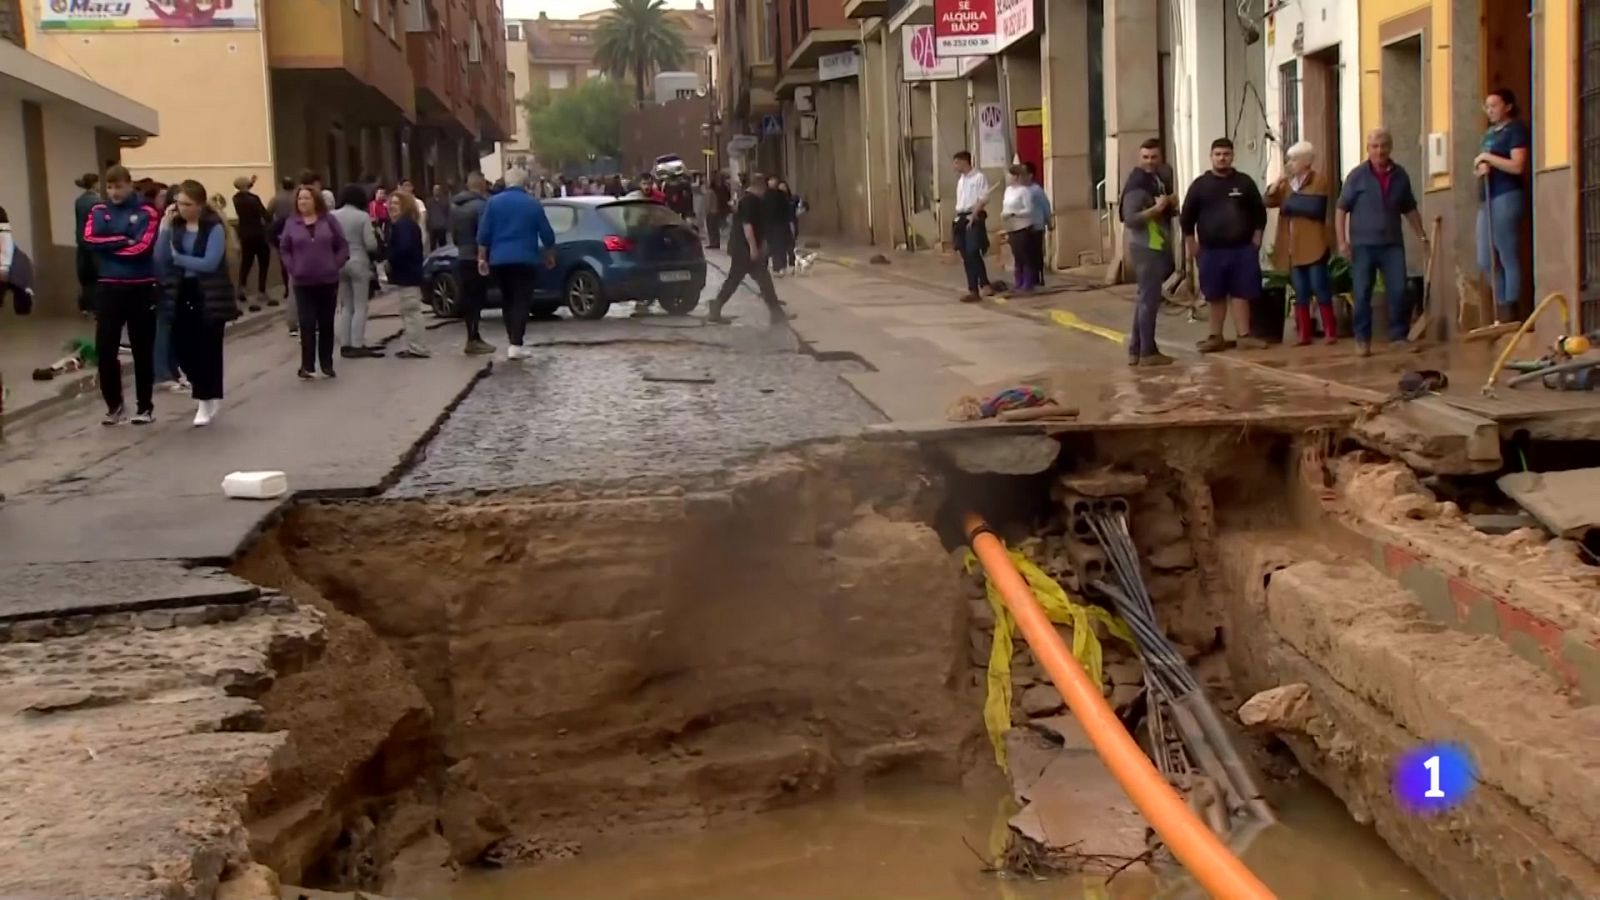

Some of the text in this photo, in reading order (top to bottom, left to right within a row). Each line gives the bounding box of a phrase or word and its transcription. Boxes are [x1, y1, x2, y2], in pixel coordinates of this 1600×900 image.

[68, 0, 131, 16] Macy
[958, 1, 971, 11] SE
[942, 10, 988, 22] ALQUILA
[951, 22, 980, 32] BAJO
